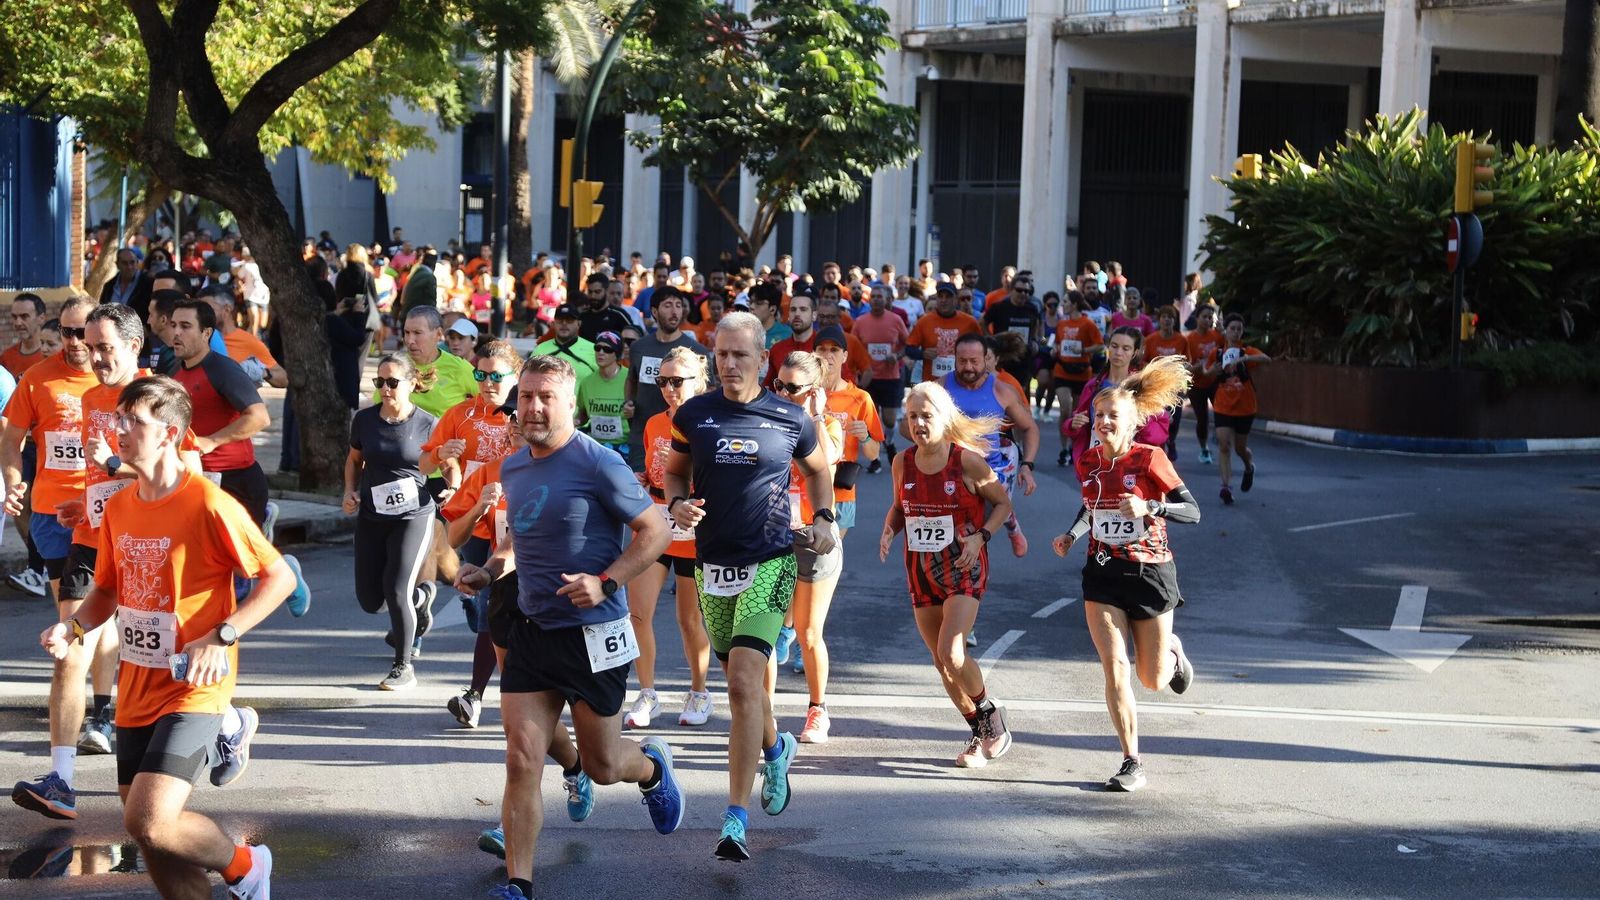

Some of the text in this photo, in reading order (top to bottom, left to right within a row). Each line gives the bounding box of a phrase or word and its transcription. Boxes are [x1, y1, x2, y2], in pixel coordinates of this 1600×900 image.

[595, 424, 616, 432] 402
[386, 493, 405, 505] 48
[1100, 521, 1135, 534] 173
[914, 528, 945, 541] 172
[711, 567, 749, 583] 706
[124, 626, 160, 650] 923
[604, 631, 627, 653] 61
